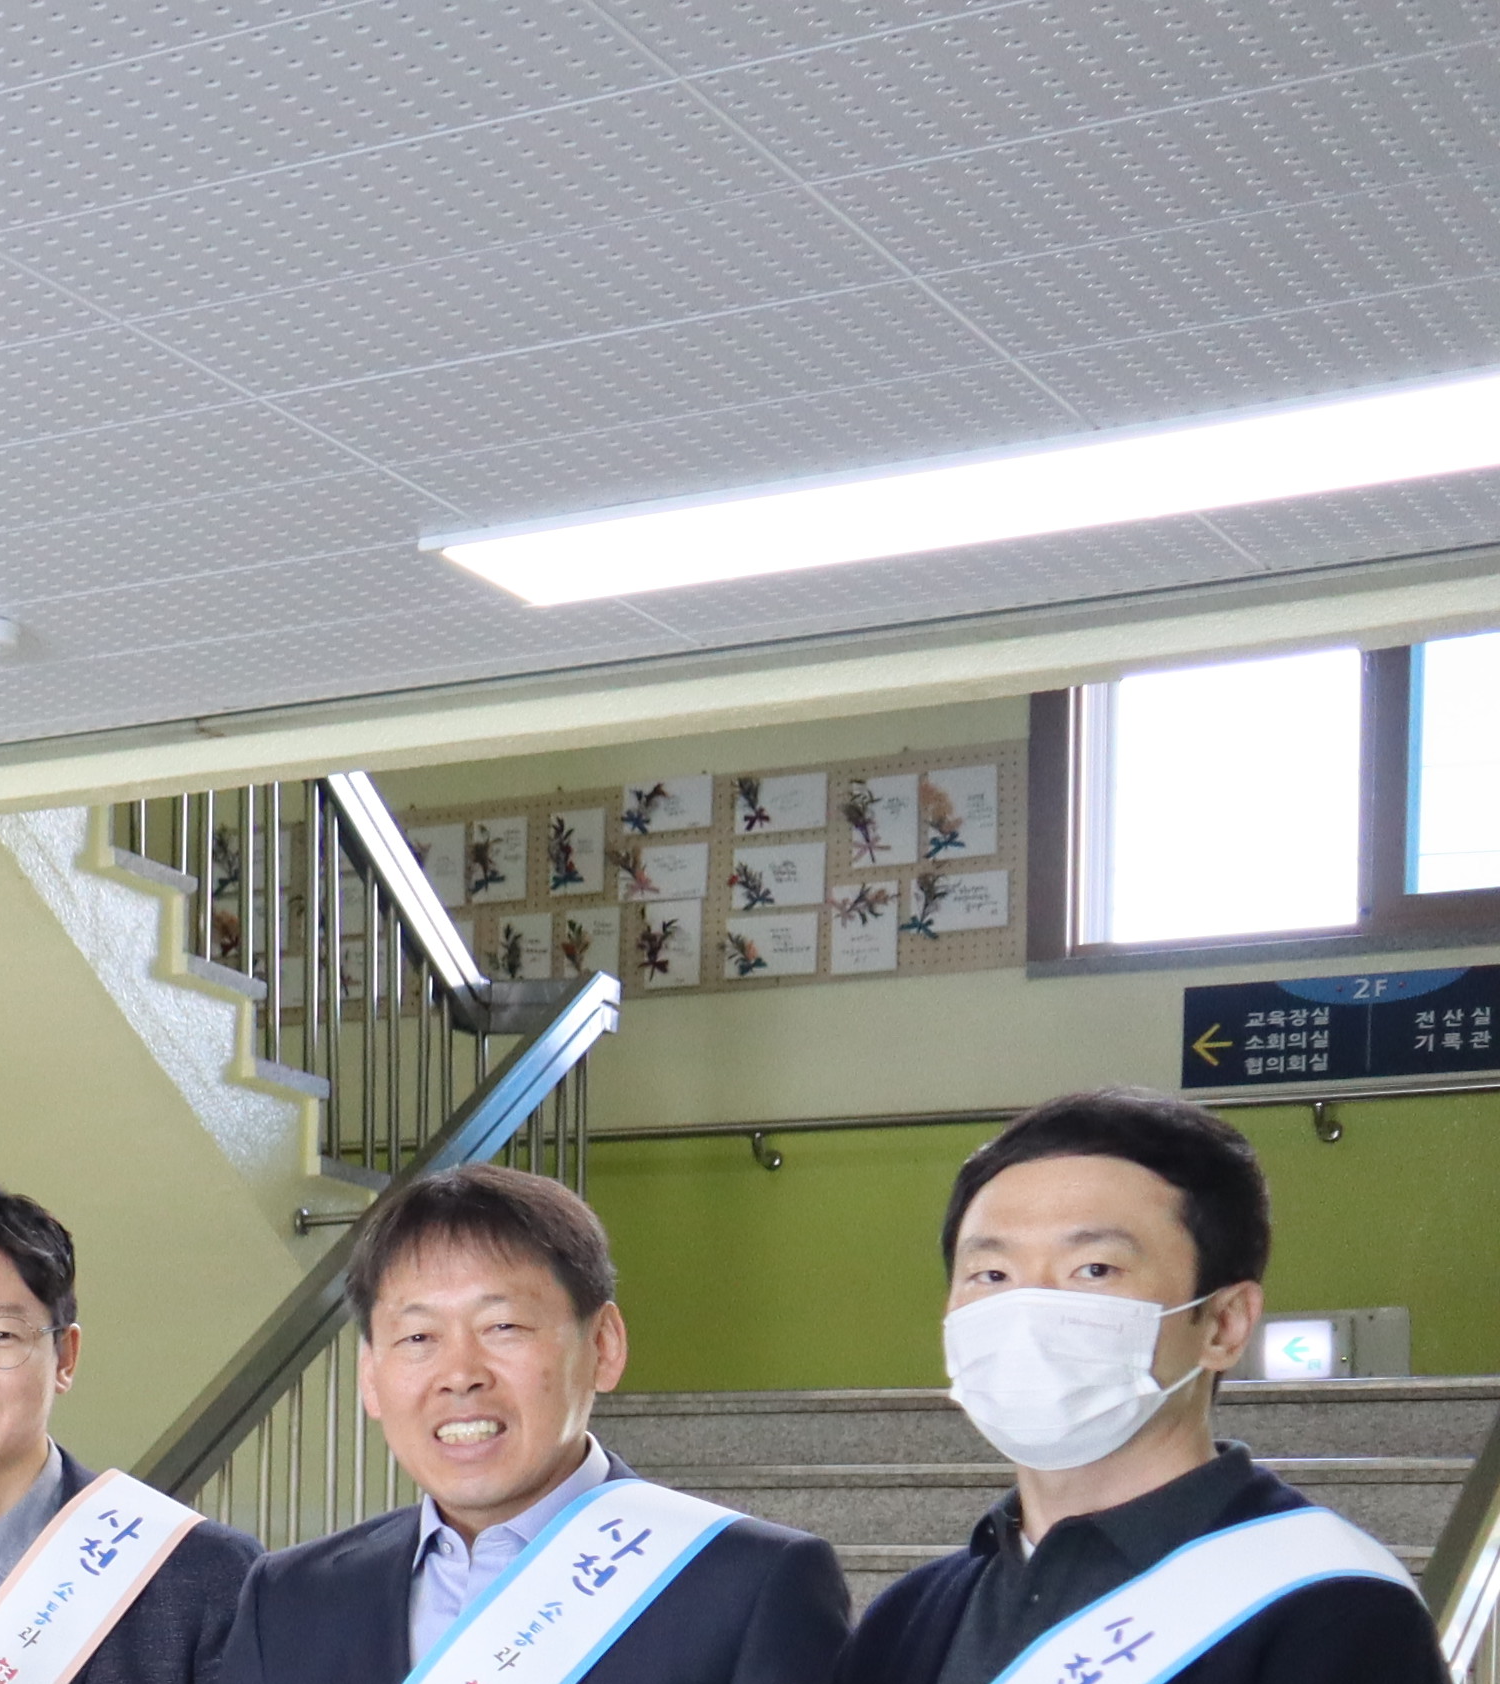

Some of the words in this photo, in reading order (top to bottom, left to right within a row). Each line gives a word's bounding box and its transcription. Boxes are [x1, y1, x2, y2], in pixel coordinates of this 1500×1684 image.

[1353, 979, 1388, 999] 2F
[1245, 1006, 1331, 1028] 교육장실
[1244, 1030, 1330, 1051] 소회의실
[1244, 1052, 1329, 1075] 협의회실
[79, 1507, 145, 1577] 사천
[571, 1516, 646, 1596] 사천
